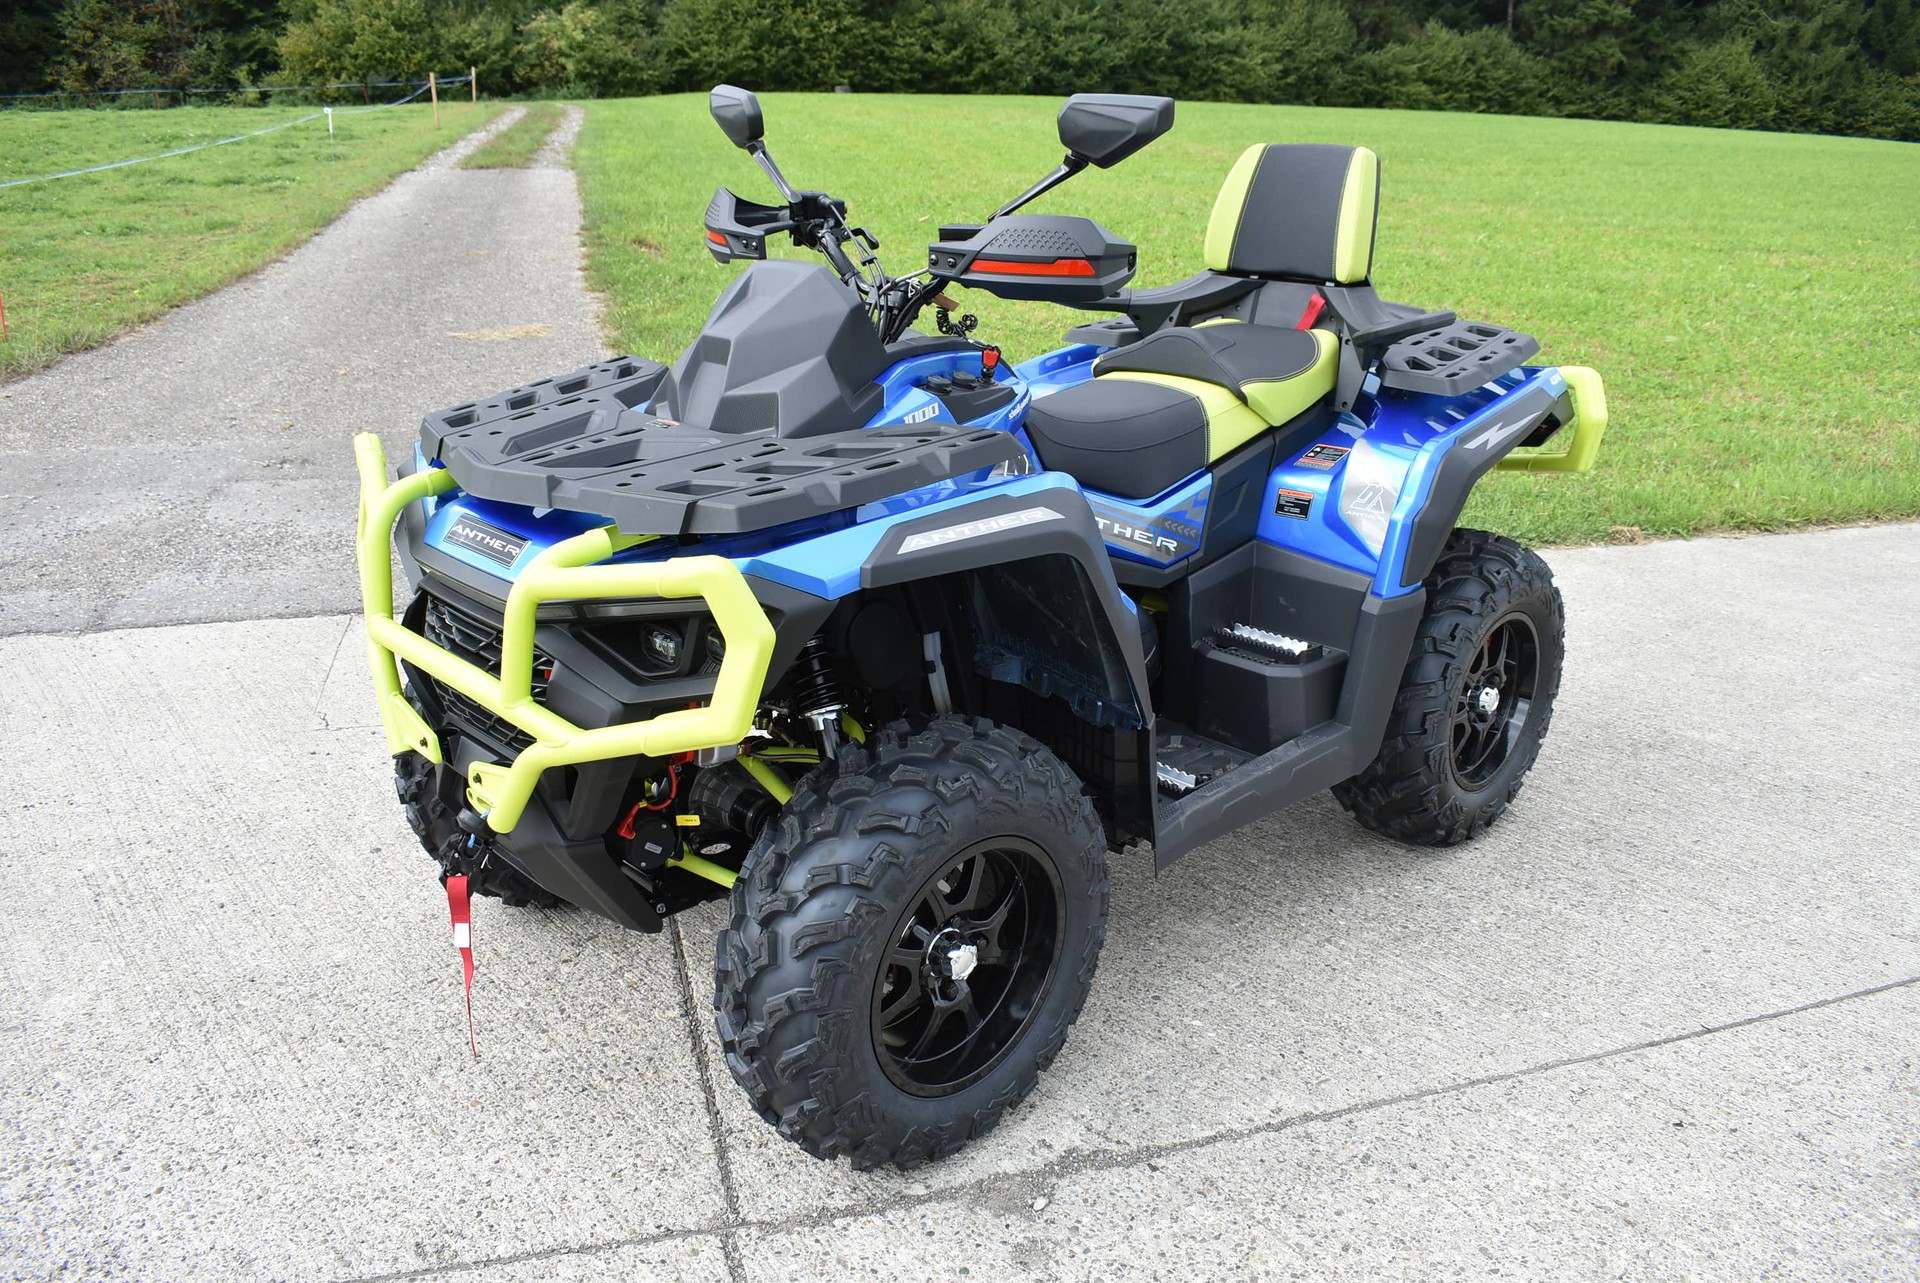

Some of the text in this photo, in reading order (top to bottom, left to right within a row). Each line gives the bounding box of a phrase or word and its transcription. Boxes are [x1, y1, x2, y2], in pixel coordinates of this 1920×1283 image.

[452, 524, 520, 557] ANTHER
[908, 510, 1046, 549] ANTHER
[1095, 516, 1178, 551] THER
